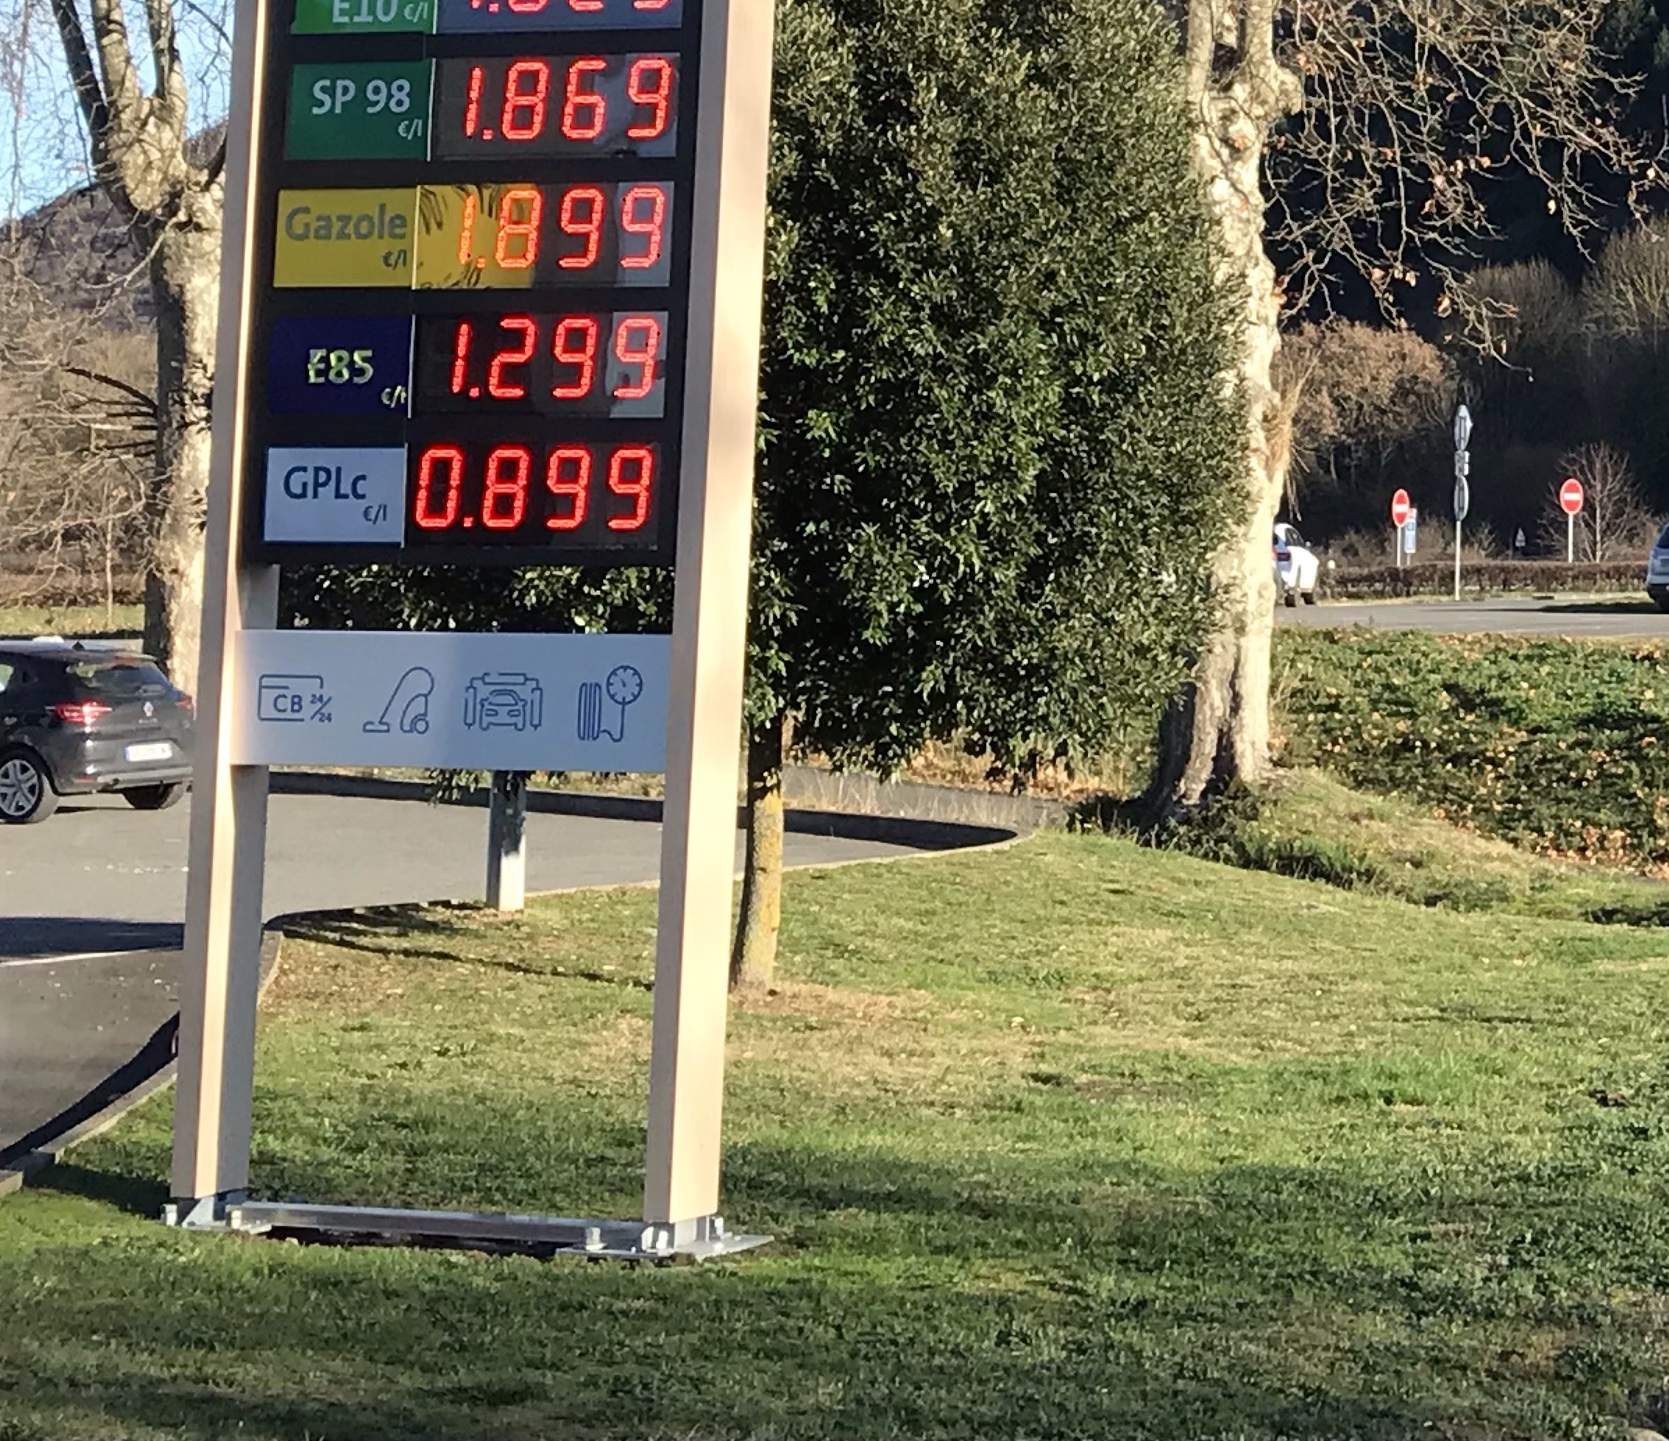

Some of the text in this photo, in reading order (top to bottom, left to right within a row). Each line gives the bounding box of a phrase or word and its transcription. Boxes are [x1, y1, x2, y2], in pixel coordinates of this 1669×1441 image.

[311, 78, 411, 115] SP 98
[463, 55, 674, 141] 1.869
[284, 205, 408, 242] Gazole
[457, 185, 668, 270] 1.899
[307, 348, 374, 384] E85
[449, 314, 663, 400] 1.299
[283, 466, 368, 501] GPLc
[413, 445, 655, 530] 0.899
[273, 694, 303, 713] CB
